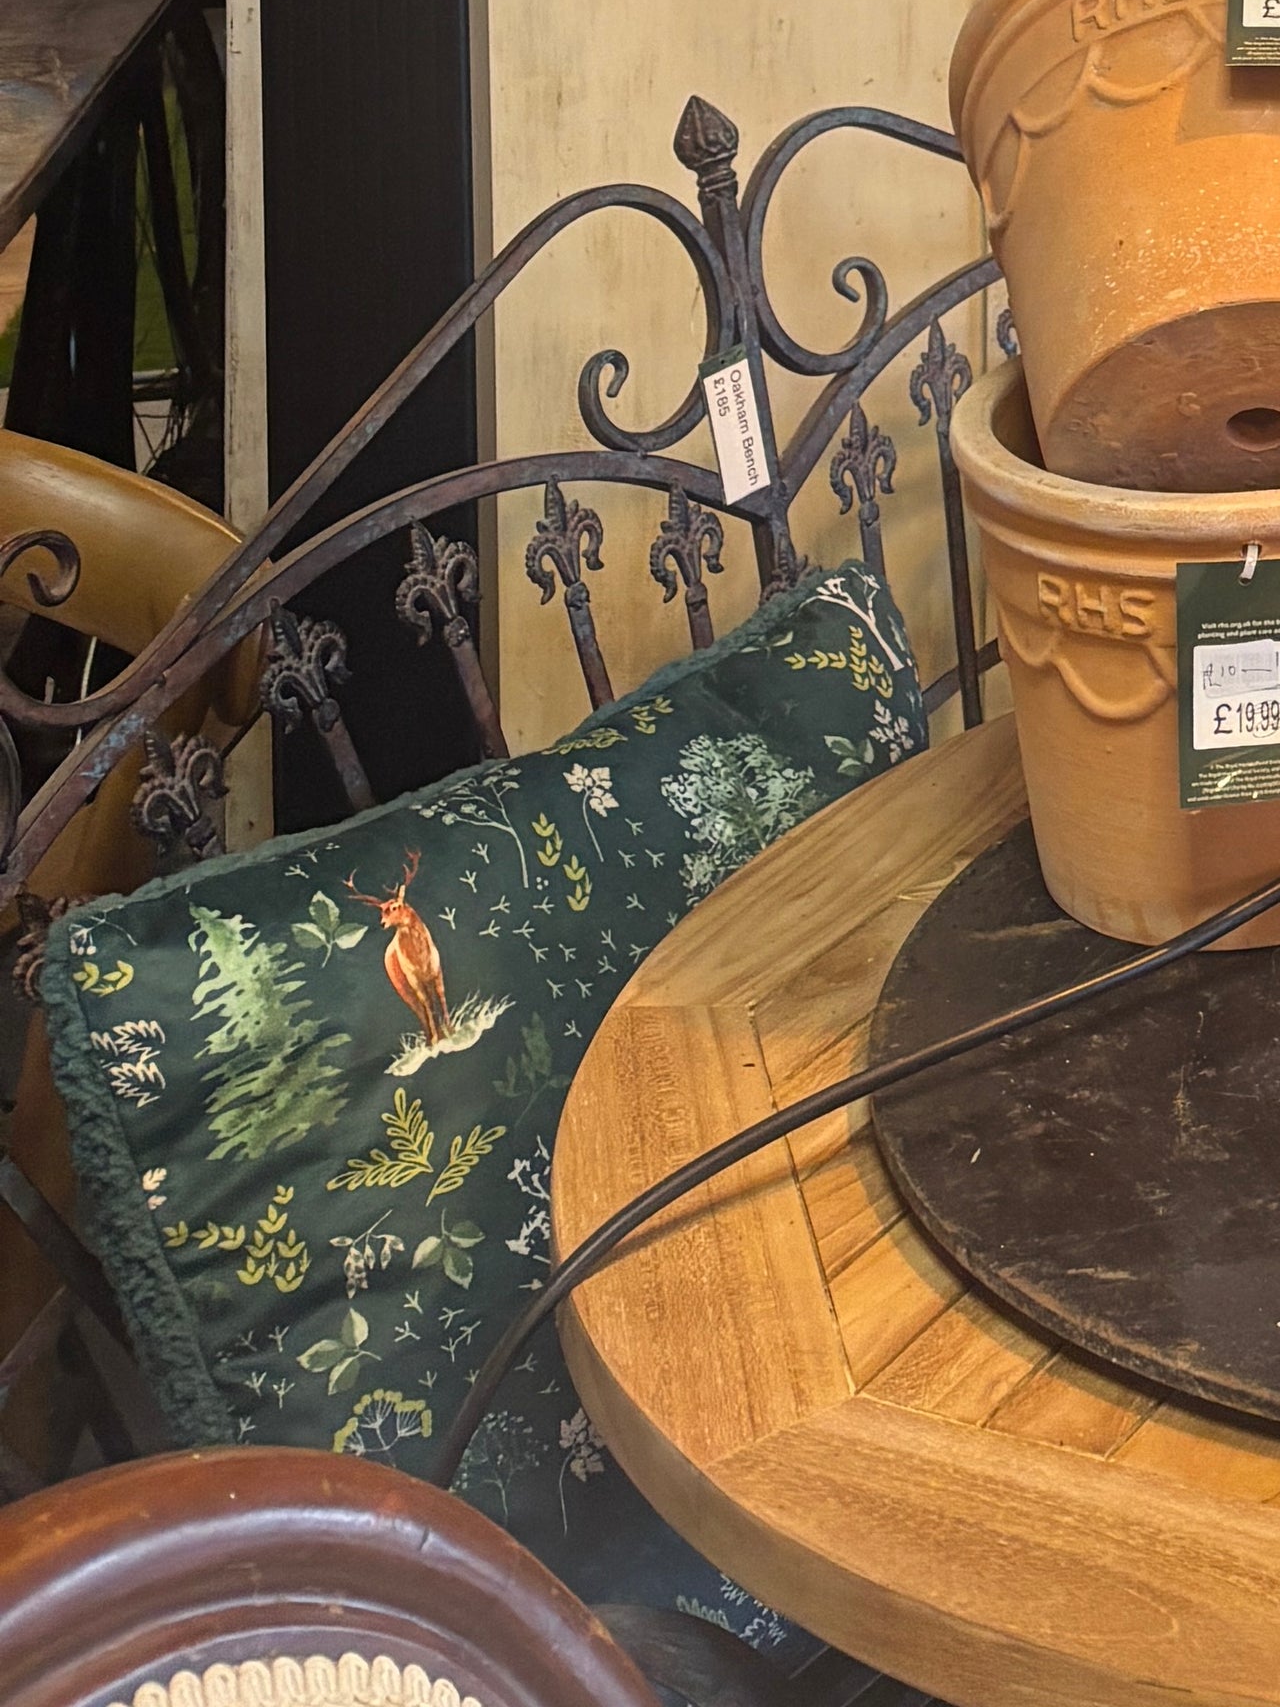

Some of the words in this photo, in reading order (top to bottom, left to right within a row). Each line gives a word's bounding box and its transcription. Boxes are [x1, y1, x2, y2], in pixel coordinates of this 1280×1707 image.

[713, 377, 731, 417] £185
[729, 369, 750, 434] Oakham
[742, 436, 760, 486] Bench
[1037, 573, 1156, 638] RHS
[1263, 618, 1275, 626] the
[1226, 629, 1239, 637] and
[1213, 699, 1280, 734] £19.99
